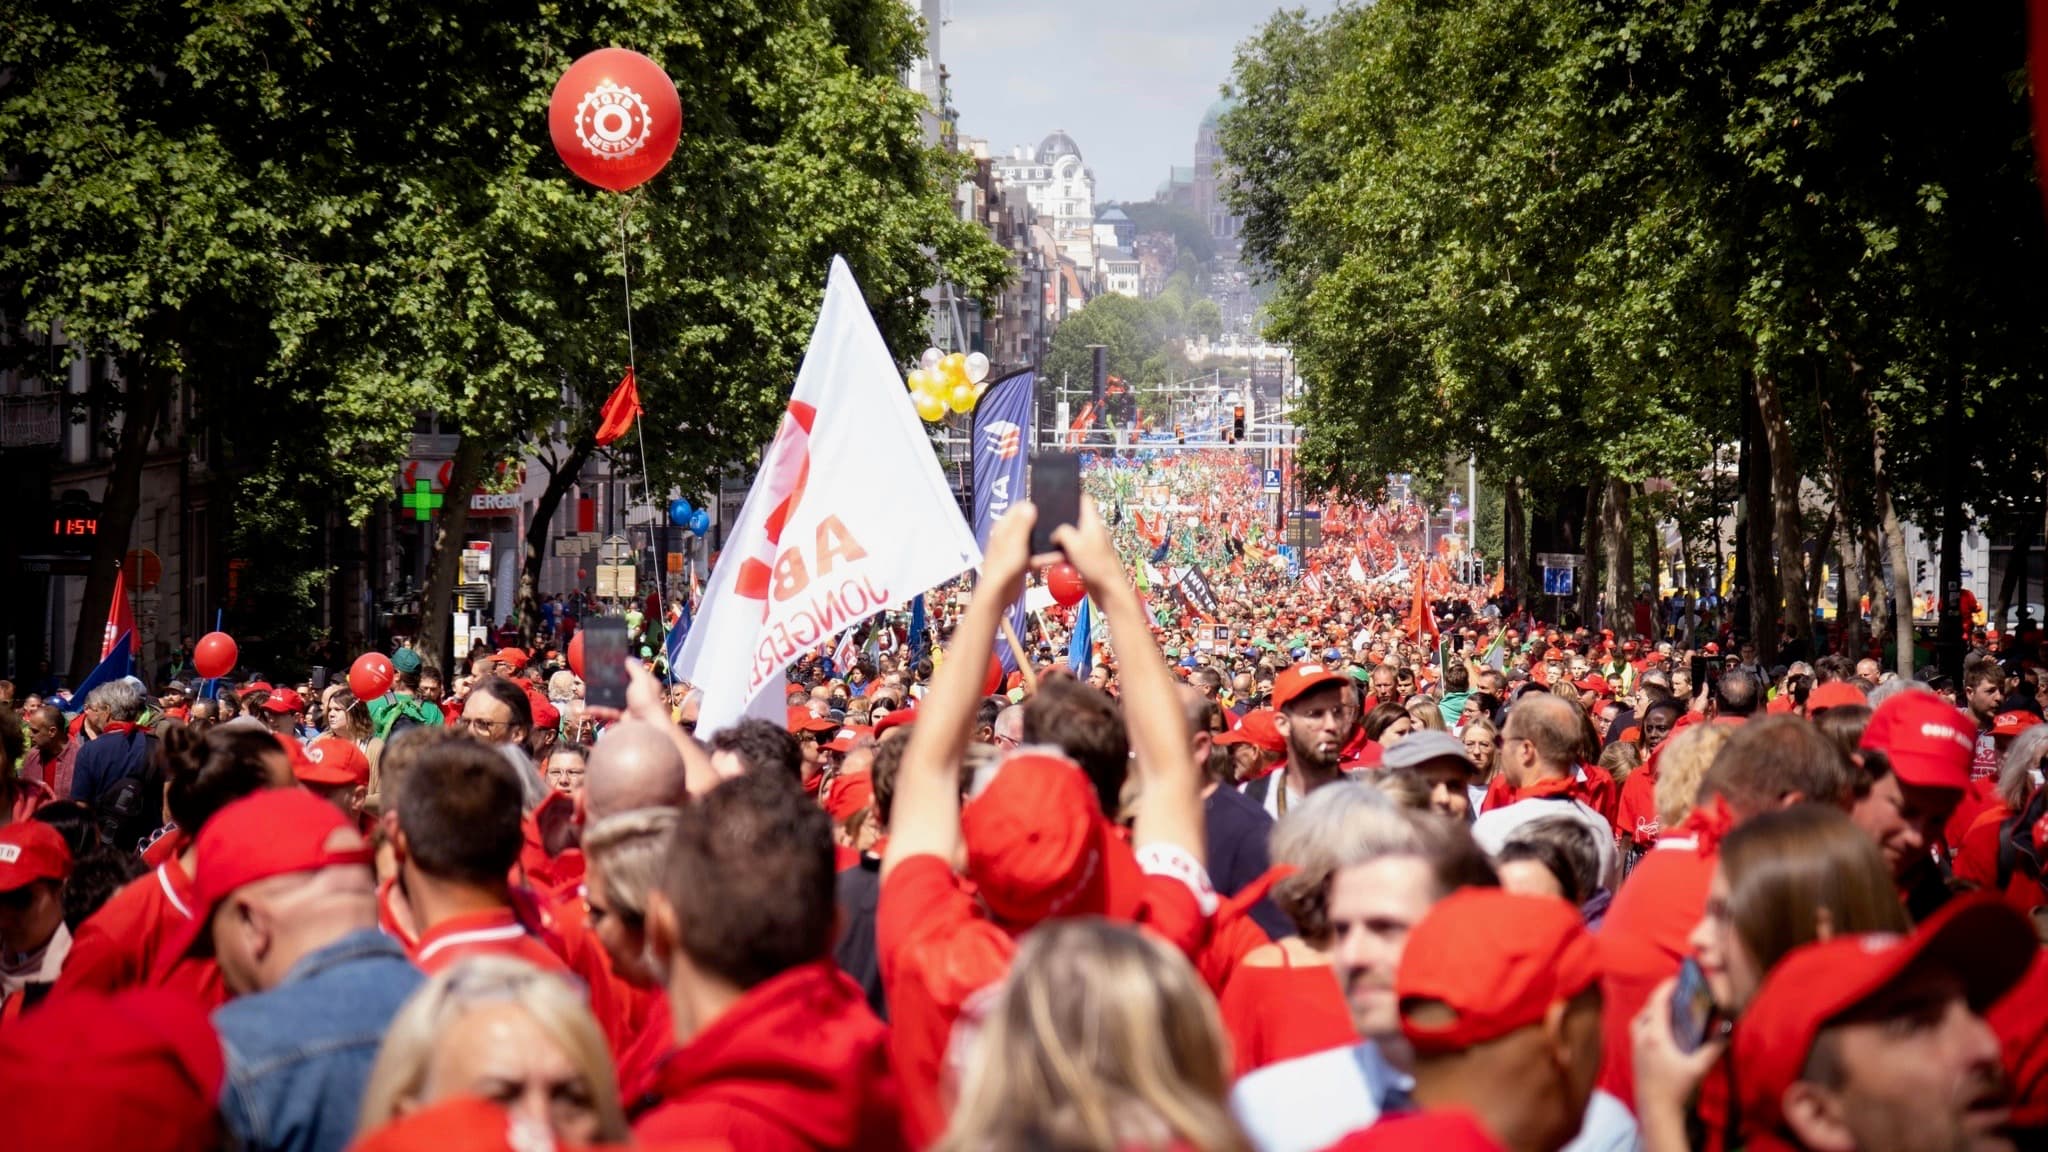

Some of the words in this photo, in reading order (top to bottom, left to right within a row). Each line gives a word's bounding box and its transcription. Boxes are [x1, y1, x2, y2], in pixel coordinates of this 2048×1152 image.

[591, 92, 633, 110] FGTB
[589, 133, 637, 152] METAL
[54, 519, 97, 535] 11:54
